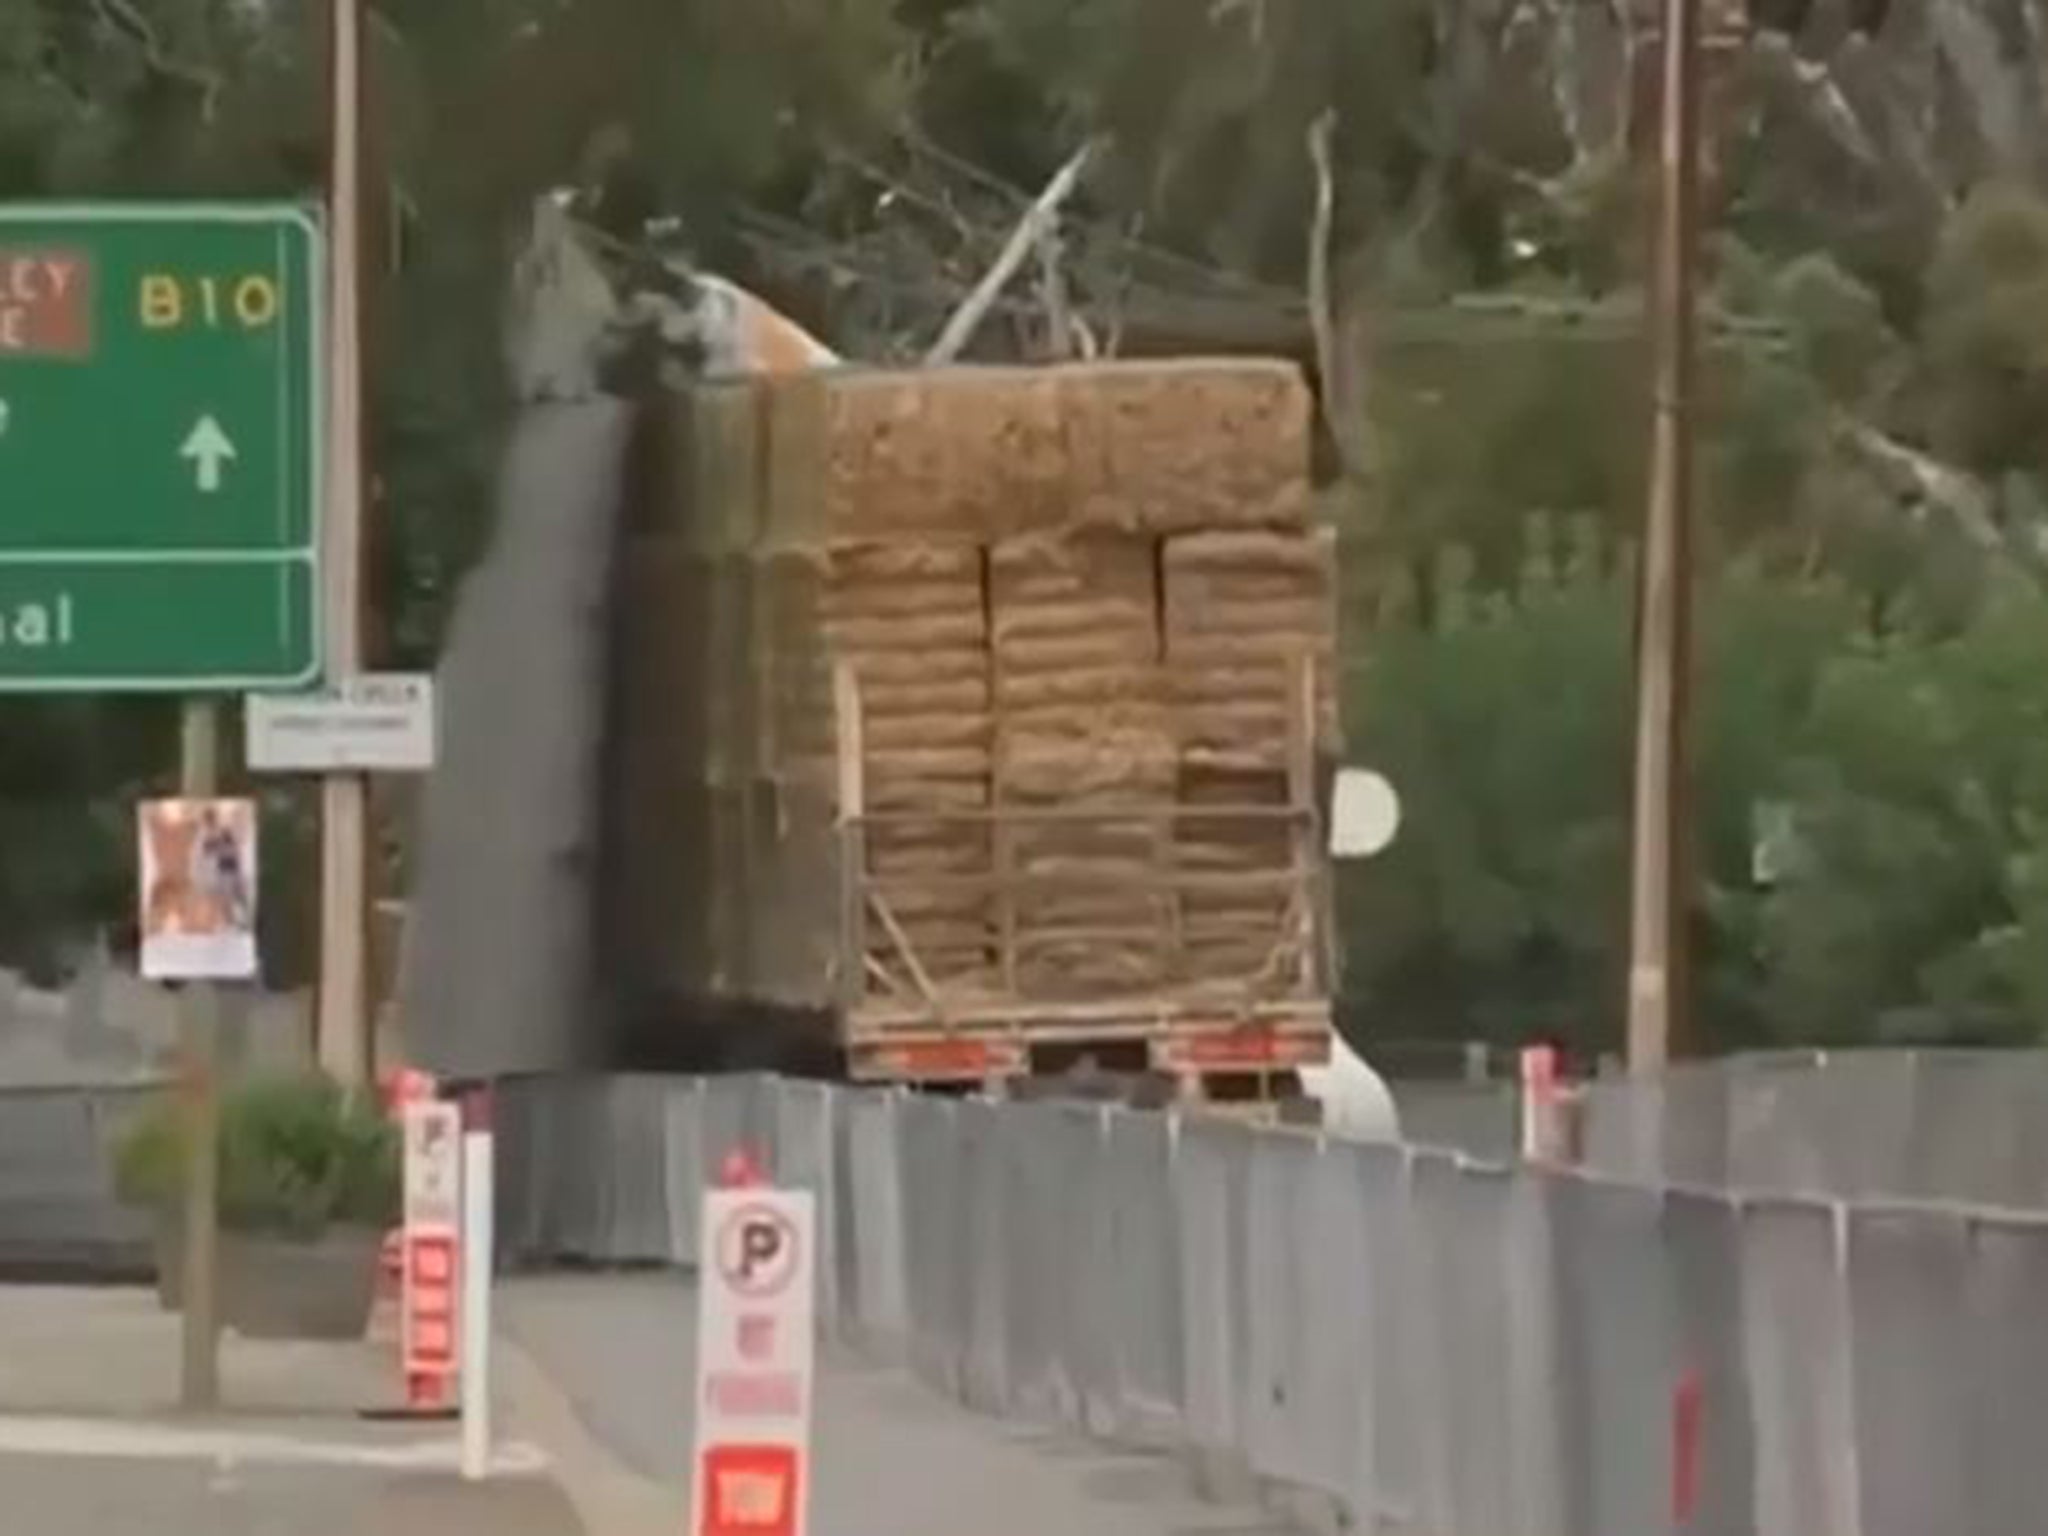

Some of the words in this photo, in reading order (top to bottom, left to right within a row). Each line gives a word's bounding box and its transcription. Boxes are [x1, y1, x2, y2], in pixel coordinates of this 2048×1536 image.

[141, 274, 276, 328] B10
[0, 593, 72, 645] al
[741, 1221, 781, 1279] P
